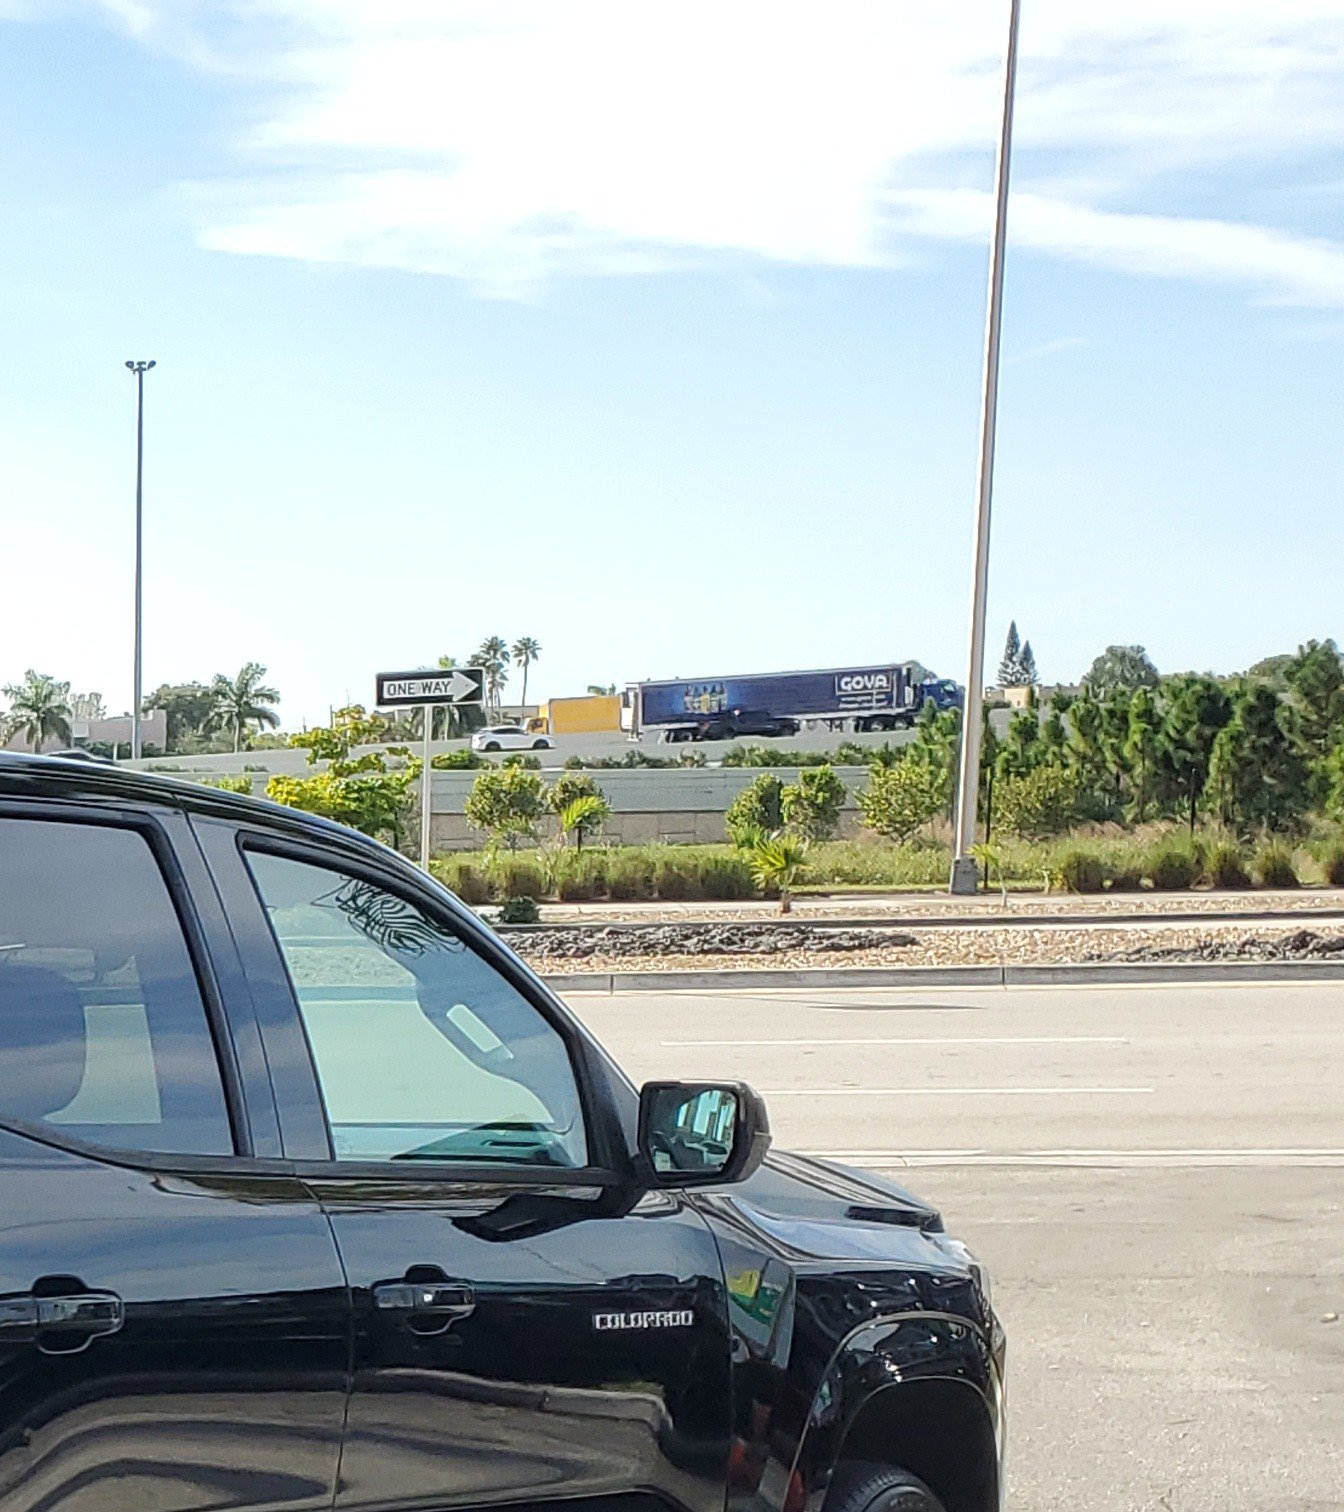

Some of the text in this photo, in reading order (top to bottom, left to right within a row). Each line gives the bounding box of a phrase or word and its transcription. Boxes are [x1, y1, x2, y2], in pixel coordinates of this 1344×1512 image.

[387, 680, 451, 696] ONE WAY
[595, 1310, 694, 1330] COLORADO
